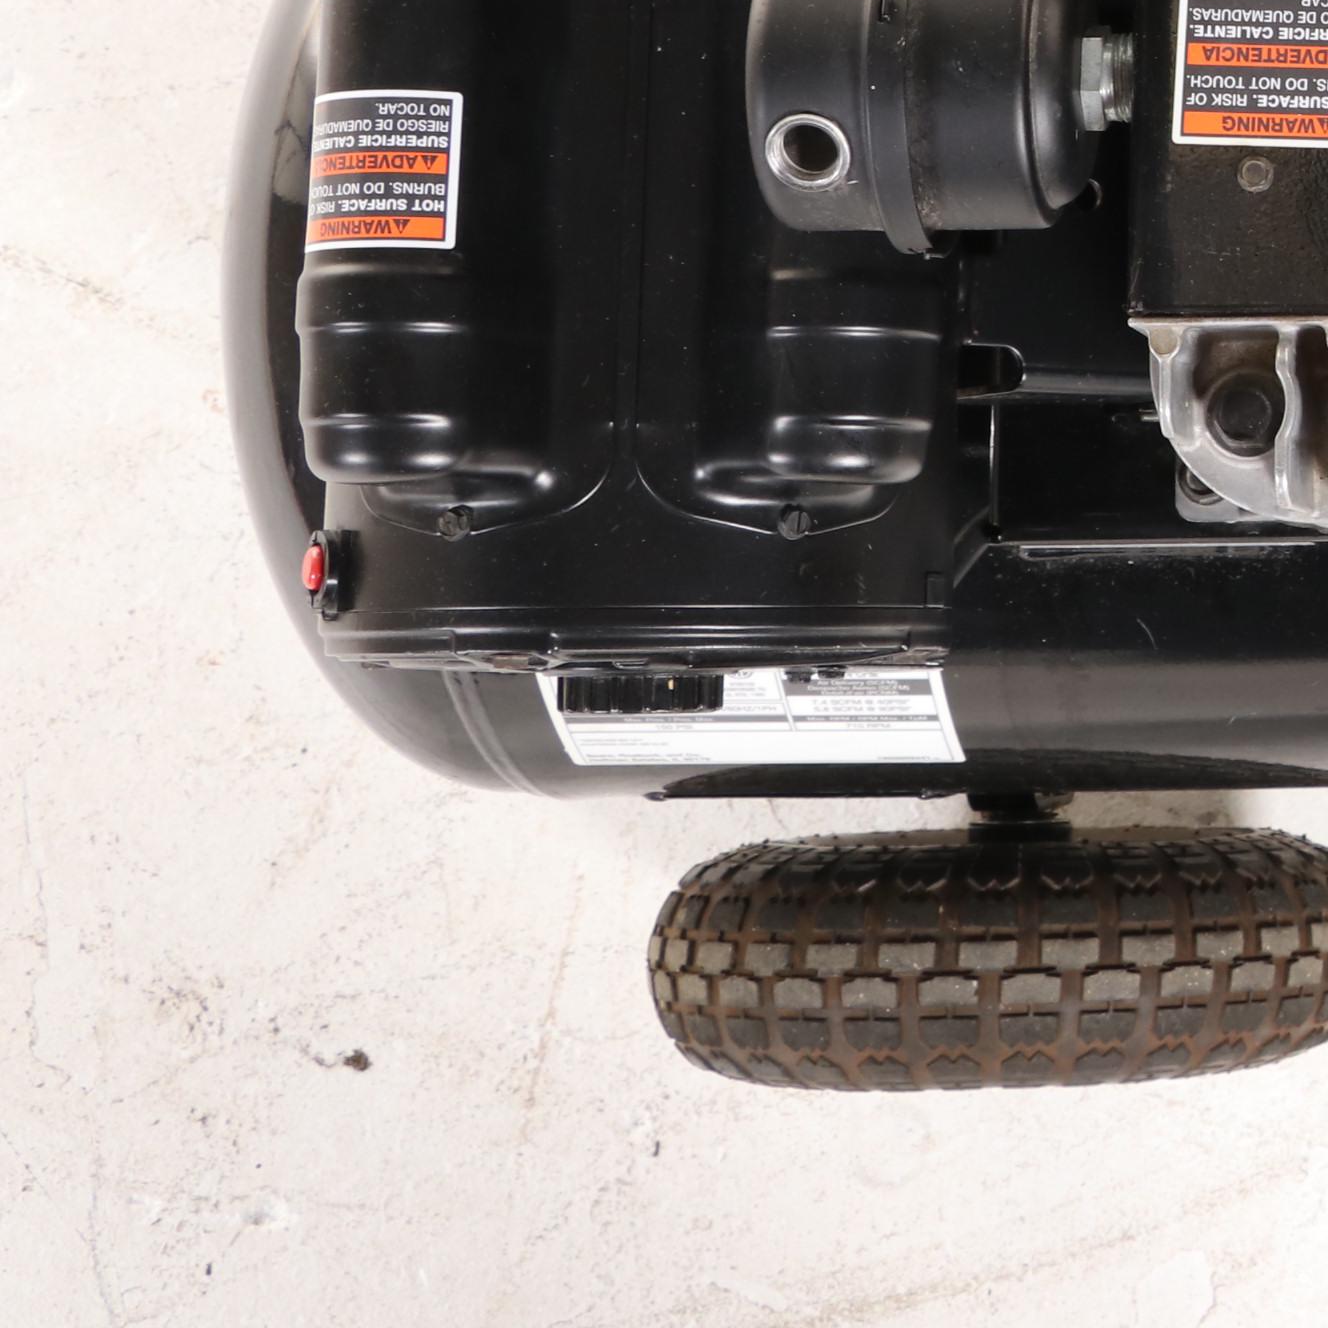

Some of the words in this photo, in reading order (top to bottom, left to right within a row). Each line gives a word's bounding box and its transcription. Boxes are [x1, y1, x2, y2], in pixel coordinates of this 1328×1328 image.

[1189, 7, 1294, 22] QUEMADURAS.
[1297, 11, 1317, 23] DE
[1189, 24, 1274, 39] CALIENTE.
[1186, 75, 1245, 89] TOUCH.
[1249, 77, 1281, 89] NOT
[1285, 77, 1308, 90] DO
[1186, 92, 1207, 105] OF
[1211, 93, 1248, 106] RISK
[375, 103, 426, 116] TOCAR.
[429, 104, 450, 116] NO
[375, 119, 394, 131] DE
[397, 119, 449, 132] RIESGO
[1222, 116, 1316, 134] WARNING
[358, 134, 449, 148] SUPERFICIE
[336, 183, 360, 195] NOT
[363, 182, 385, 195] DO
[389, 182, 445, 195] BURNS.
[316, 201, 335, 212] RISK
[338, 199, 408, 211] SURFACE.
[413, 199, 445, 212] HOT
[320, 219, 392, 236] WARNING
